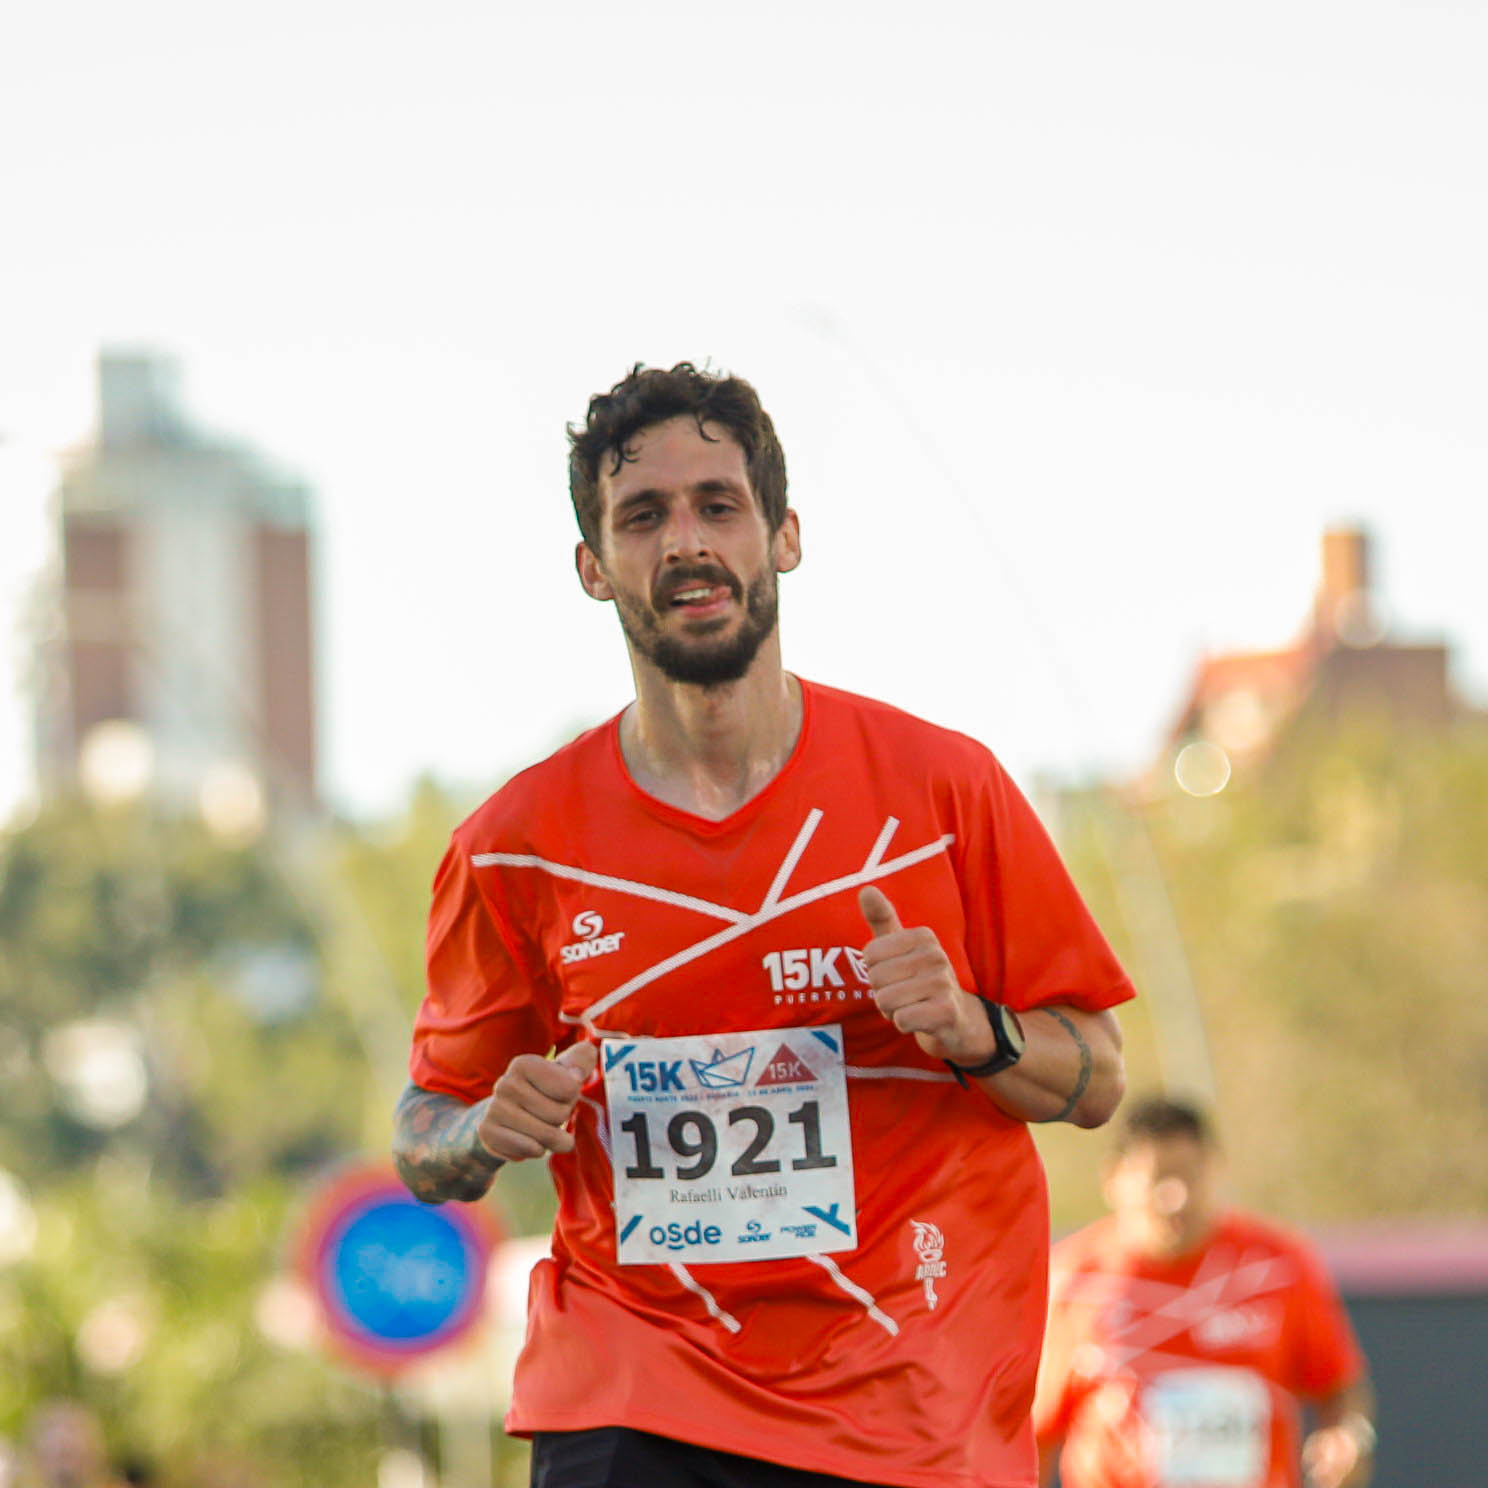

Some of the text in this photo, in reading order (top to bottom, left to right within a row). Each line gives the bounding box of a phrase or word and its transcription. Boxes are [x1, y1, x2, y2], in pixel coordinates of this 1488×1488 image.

[762, 946, 846, 992] 15K
[774, 990, 847, 1006] PUERTO
[624, 1059, 686, 1092] 15K
[768, 1061, 802, 1080] 15K
[620, 1100, 838, 1181] 1921
